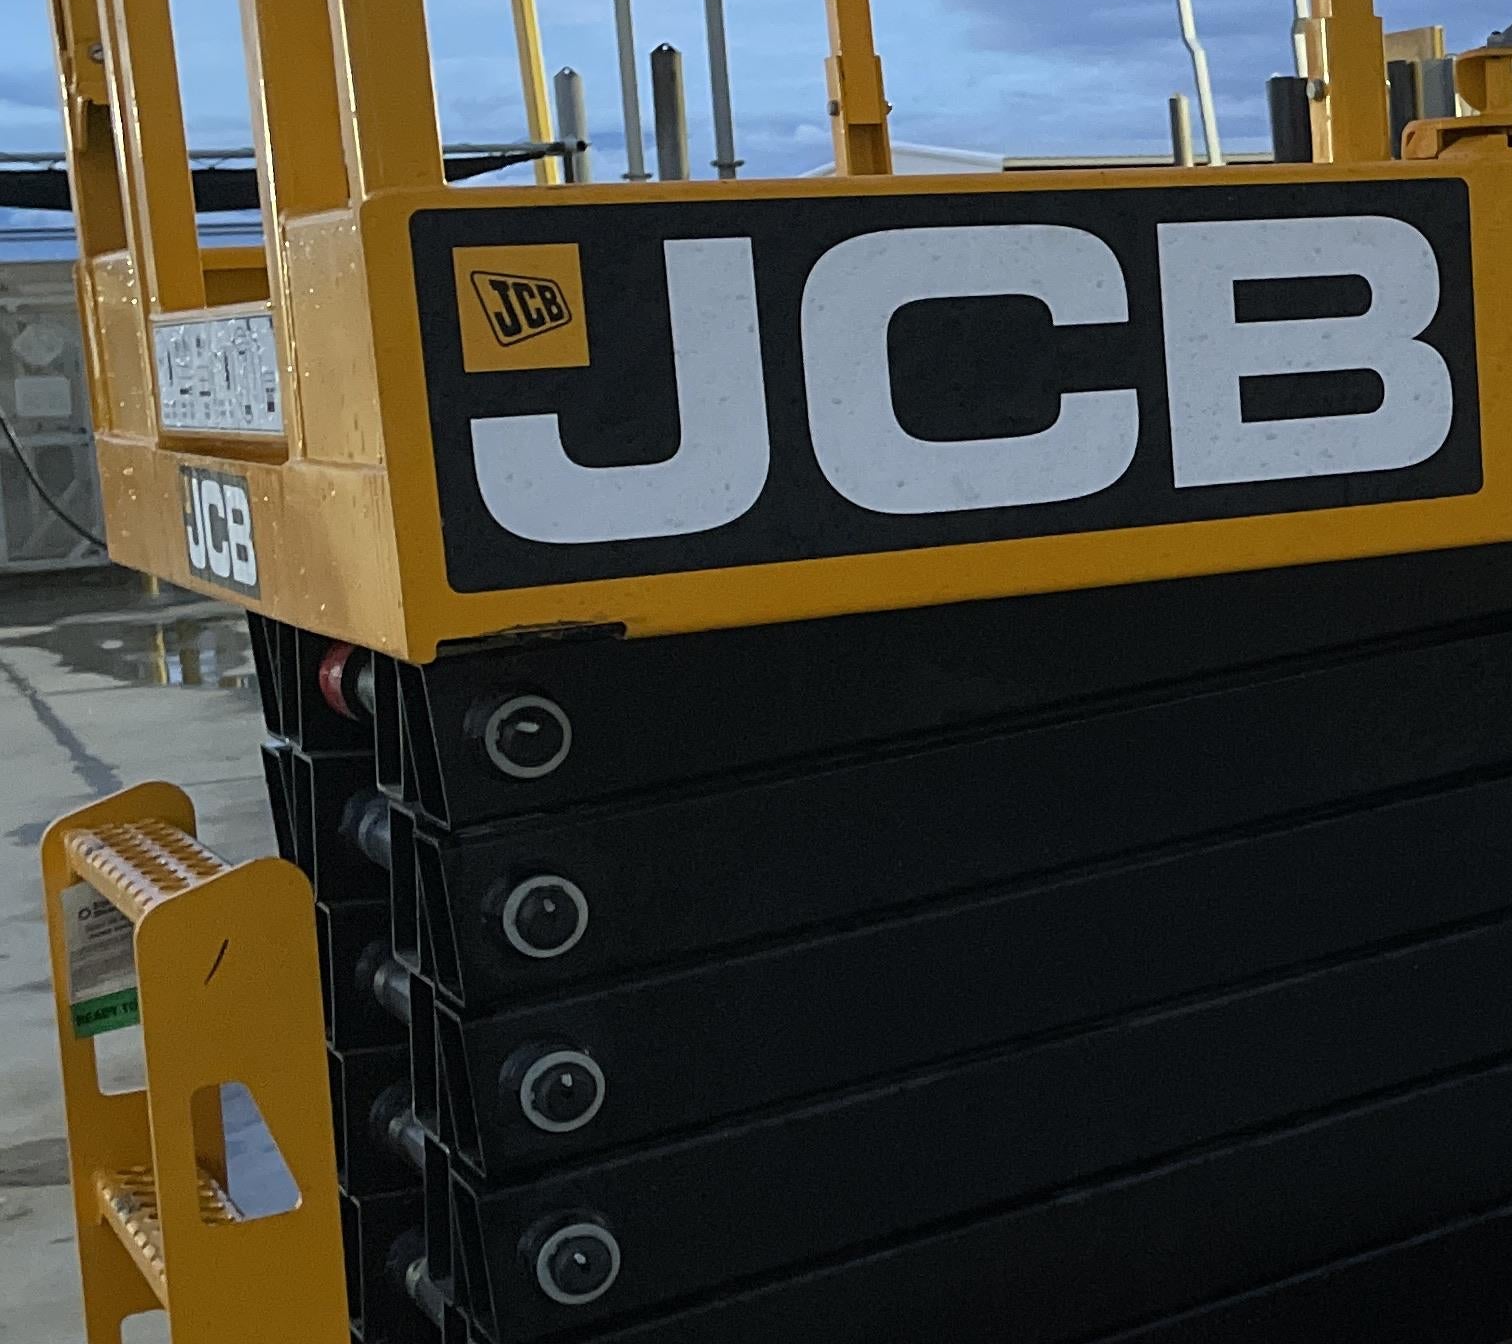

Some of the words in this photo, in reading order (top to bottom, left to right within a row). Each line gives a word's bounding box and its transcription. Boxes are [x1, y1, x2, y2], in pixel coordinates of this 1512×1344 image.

[488, 279, 565, 338] JCB
[471, 215, 1454, 545] JCB
[186, 477, 258, 587] JCB
